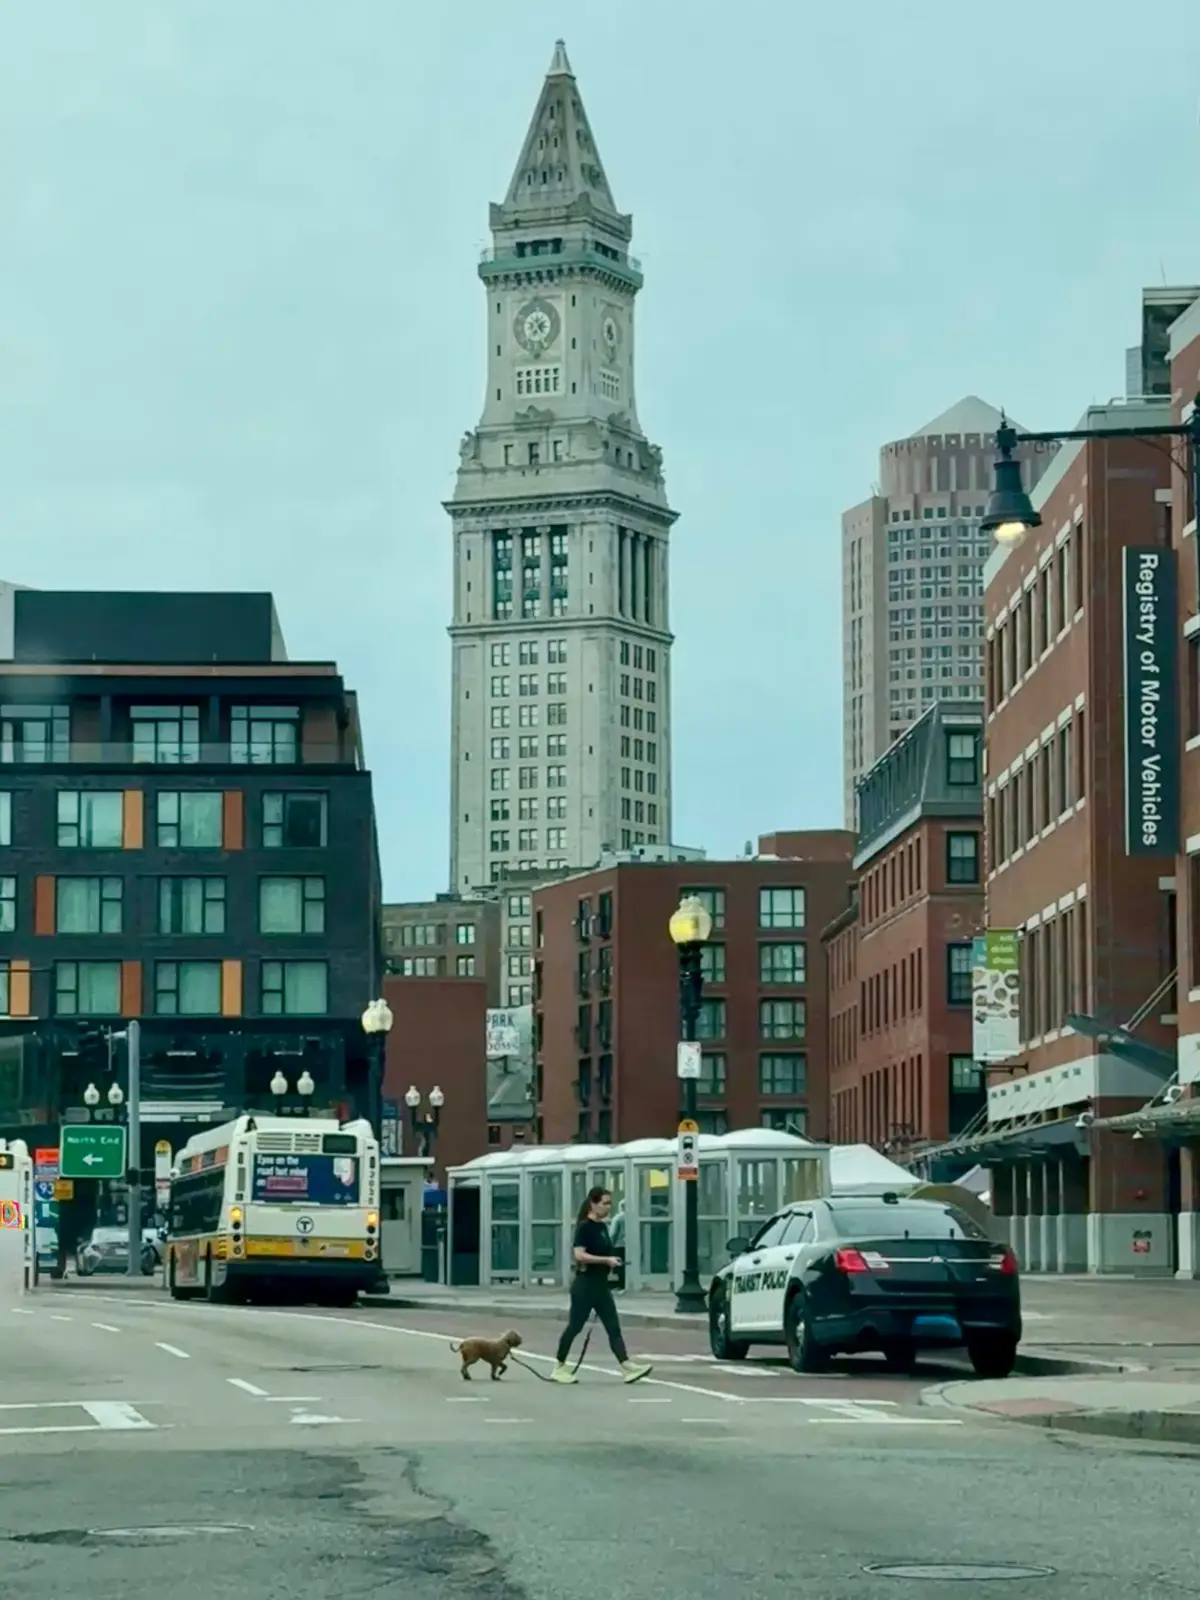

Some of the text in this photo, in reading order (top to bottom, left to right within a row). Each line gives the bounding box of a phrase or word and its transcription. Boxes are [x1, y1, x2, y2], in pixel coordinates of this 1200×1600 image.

[1135, 553, 1162, 846] Registry of Motor Vehicles
[67, 1136, 121, 1145] North End
[734, 1270, 788, 1294] TRANSIT POLICE
